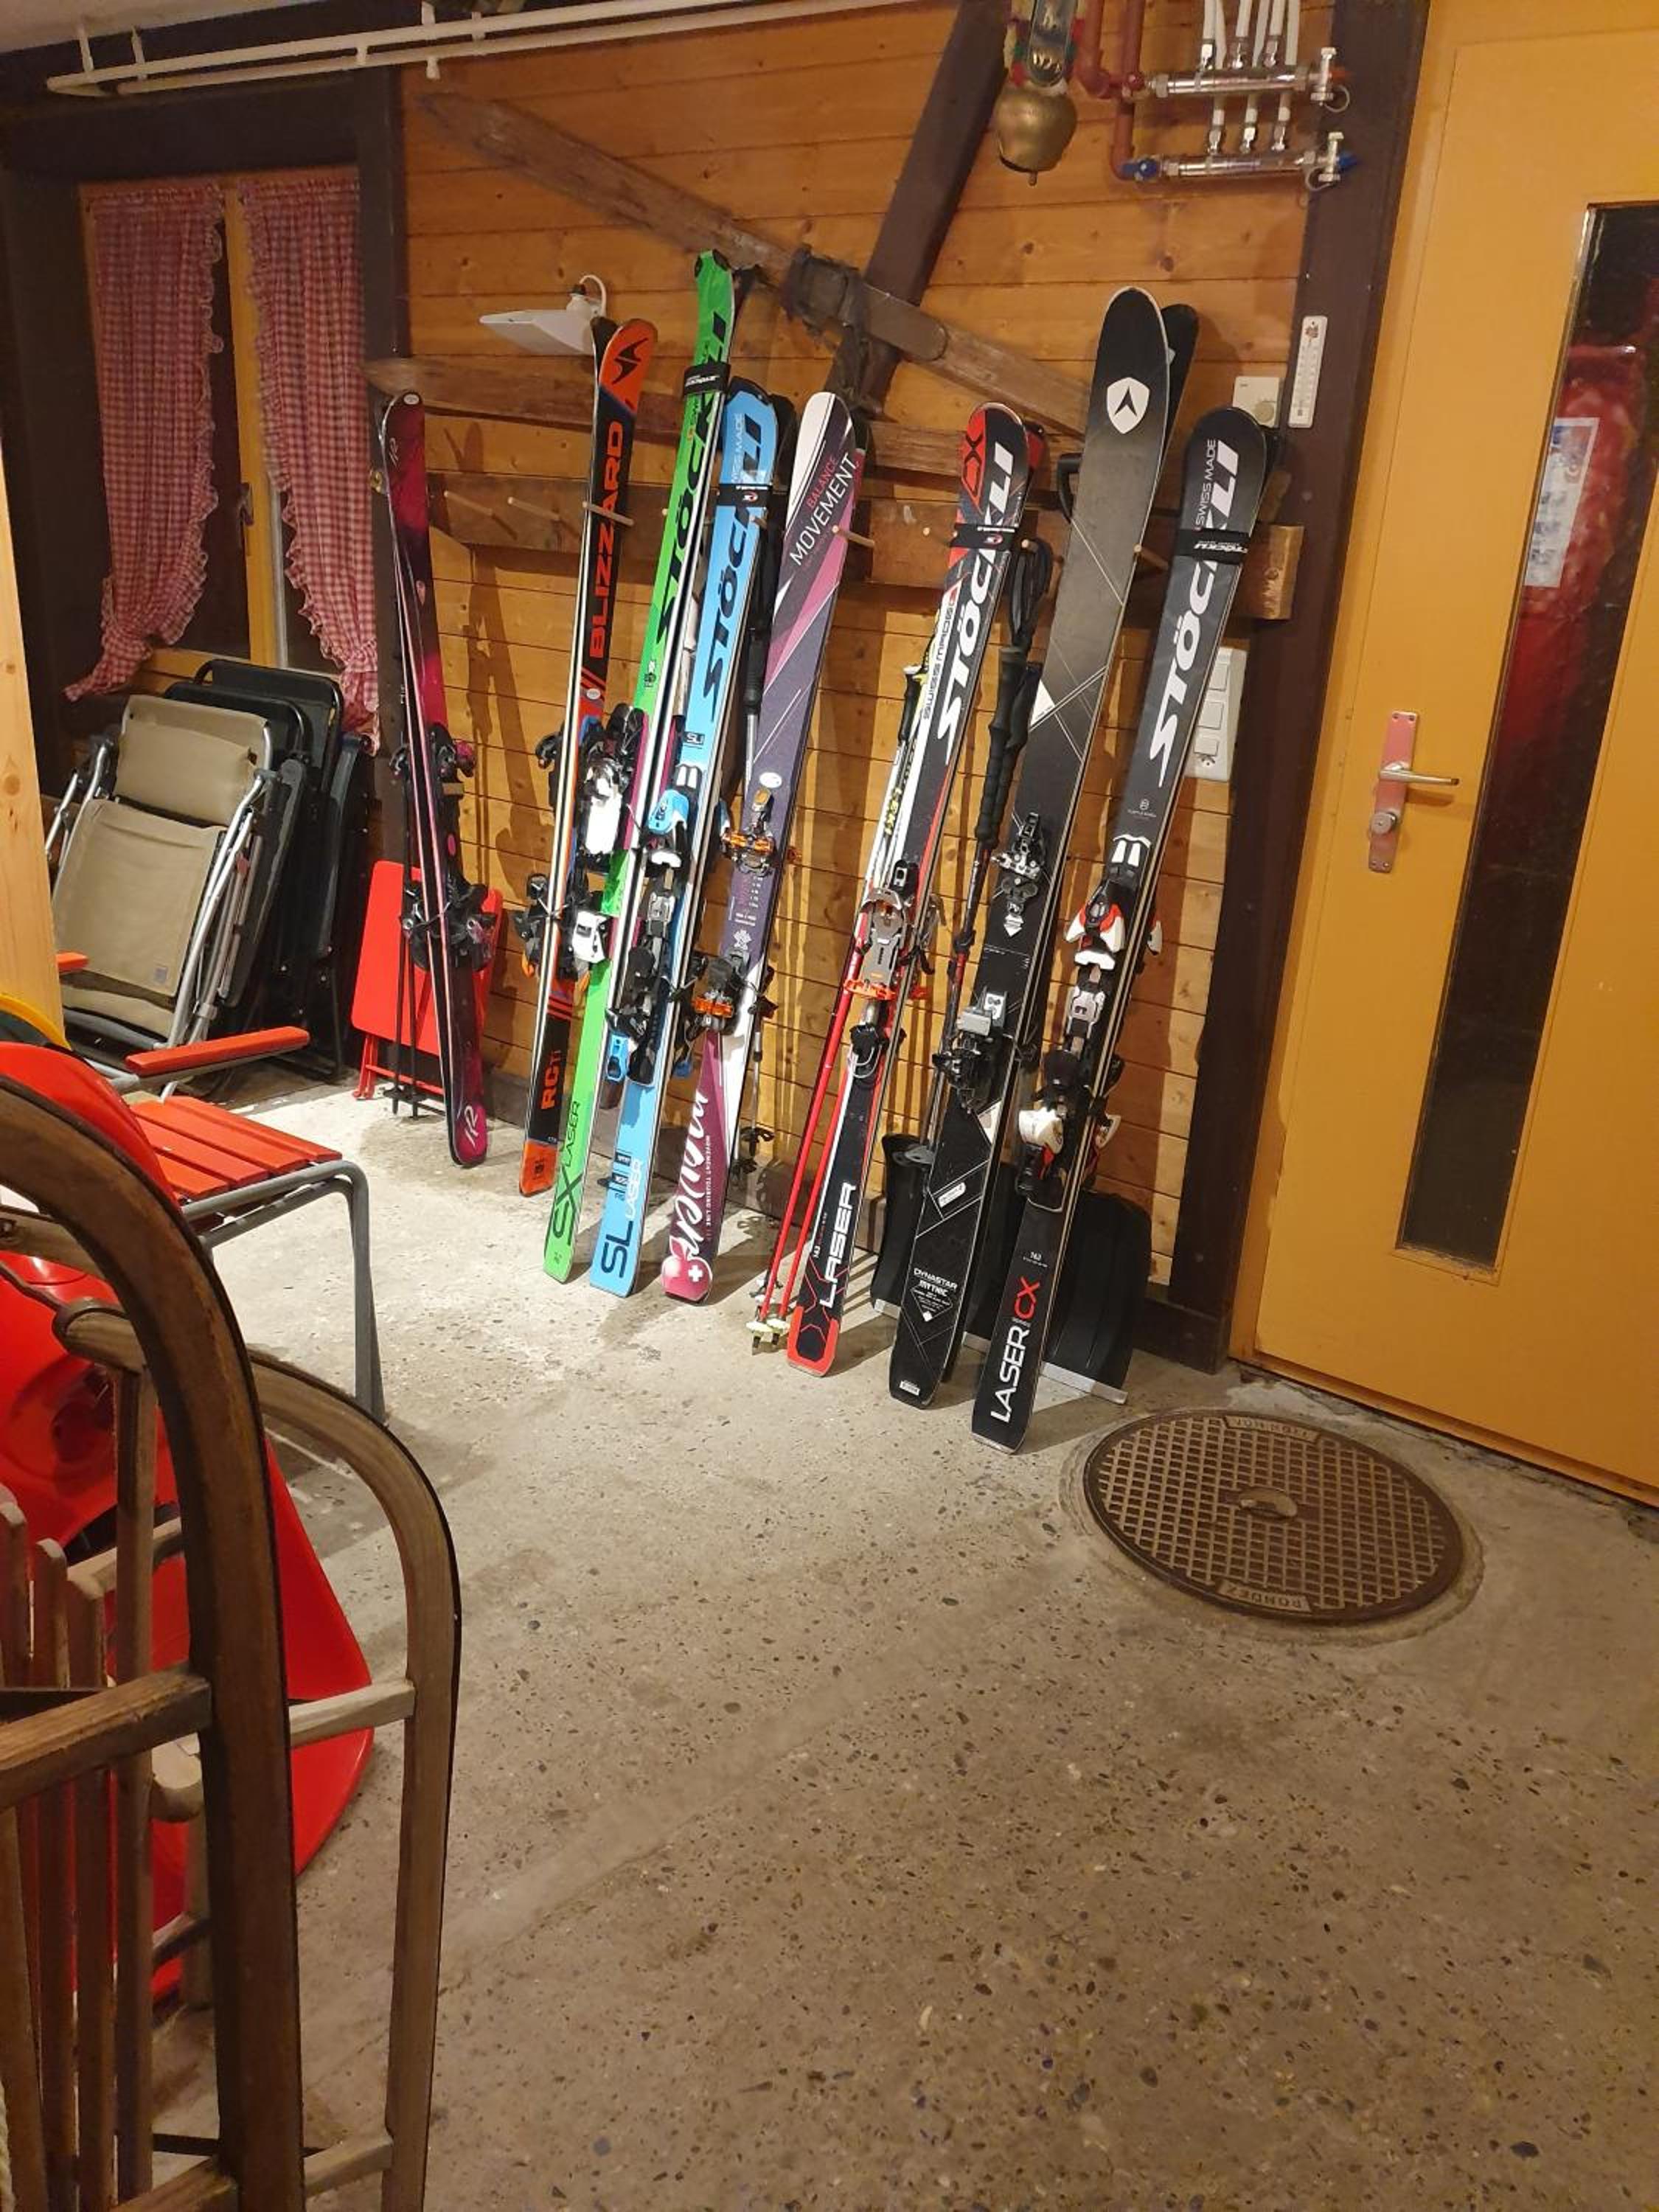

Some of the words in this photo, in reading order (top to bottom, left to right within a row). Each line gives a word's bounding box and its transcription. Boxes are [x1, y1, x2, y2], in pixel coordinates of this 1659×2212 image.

[790, 452, 858, 566] MOVEMENT
[807, 455, 838, 511] BALANCE
[1194, 483, 1211, 526] SWISS
[1204, 439, 1217, 480] MADE
[589, 420, 623, 658] BLIZZARD
[541, 1062, 560, 1109] RC
[559, 1101, 581, 1167] LASER
[553, 1165, 583, 1246] SX
[625, 1159, 643, 1219] LASER
[601, 1220, 634, 1279] SL
[819, 1182, 857, 1309] LASER
[914, 1267, 958, 1290] DYNASTAR
[919, 1279, 949, 1298] MYTHIC
[990, 1325, 1031, 1424] LASER
[1014, 1276, 1041, 1321] CX
